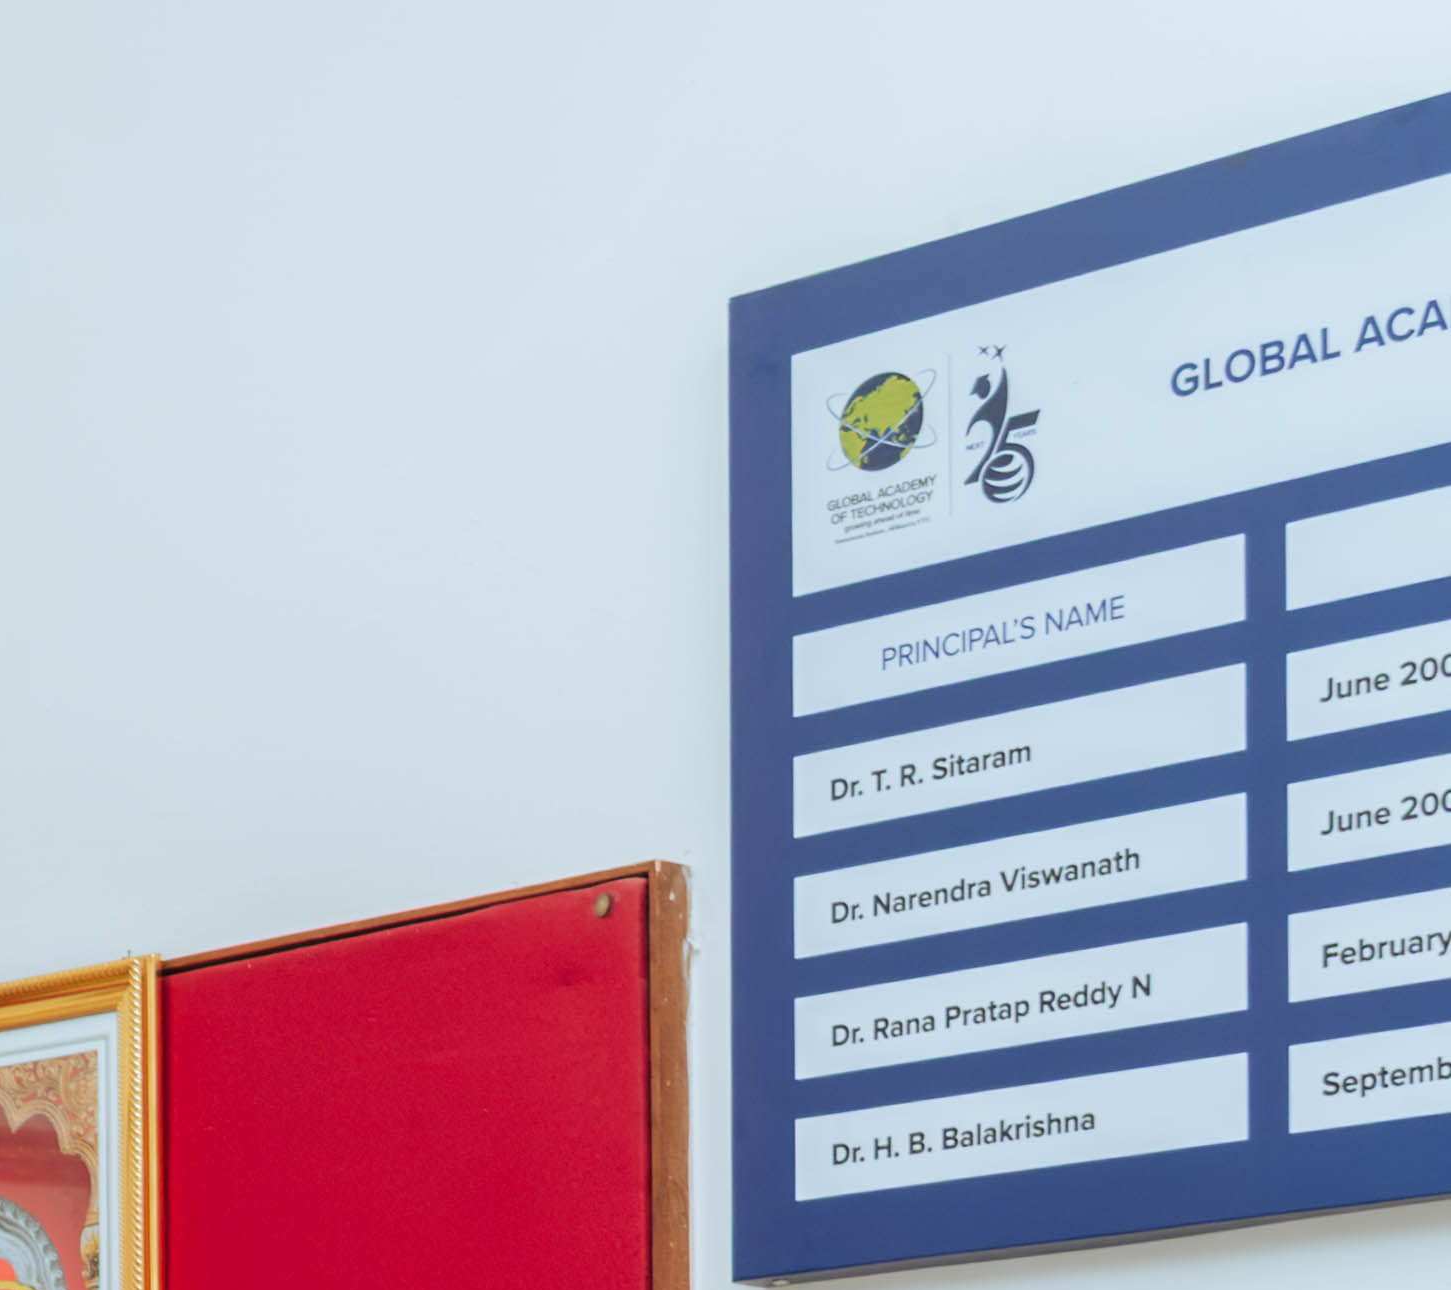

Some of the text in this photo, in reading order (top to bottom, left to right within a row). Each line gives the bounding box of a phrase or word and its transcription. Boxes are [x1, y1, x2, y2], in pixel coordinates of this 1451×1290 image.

[1171, 295, 1451, 397] GLOBAL ACA
[827, 474, 937, 511] GLOBAL ACADEMY
[831, 490, 934, 525] OF TECHNOLOGY
[882, 594, 1126, 671] PRINCIPAL'S NAME
[1319, 672, 1390, 703] June
[830, 744, 1032, 801] Dr. T. R. Sitaram
[1320, 807, 1391, 836] June
[831, 848, 1140, 924] Dr. Narendra Viswanath
[1321, 930, 1451, 968] February
[832, 973, 1152, 1047] Dr. Rana Pratap Reddy N
[1322, 1056, 1451, 1097] Septemb
[832, 1111, 1095, 1166] Dr. H. B. Balakrishna
